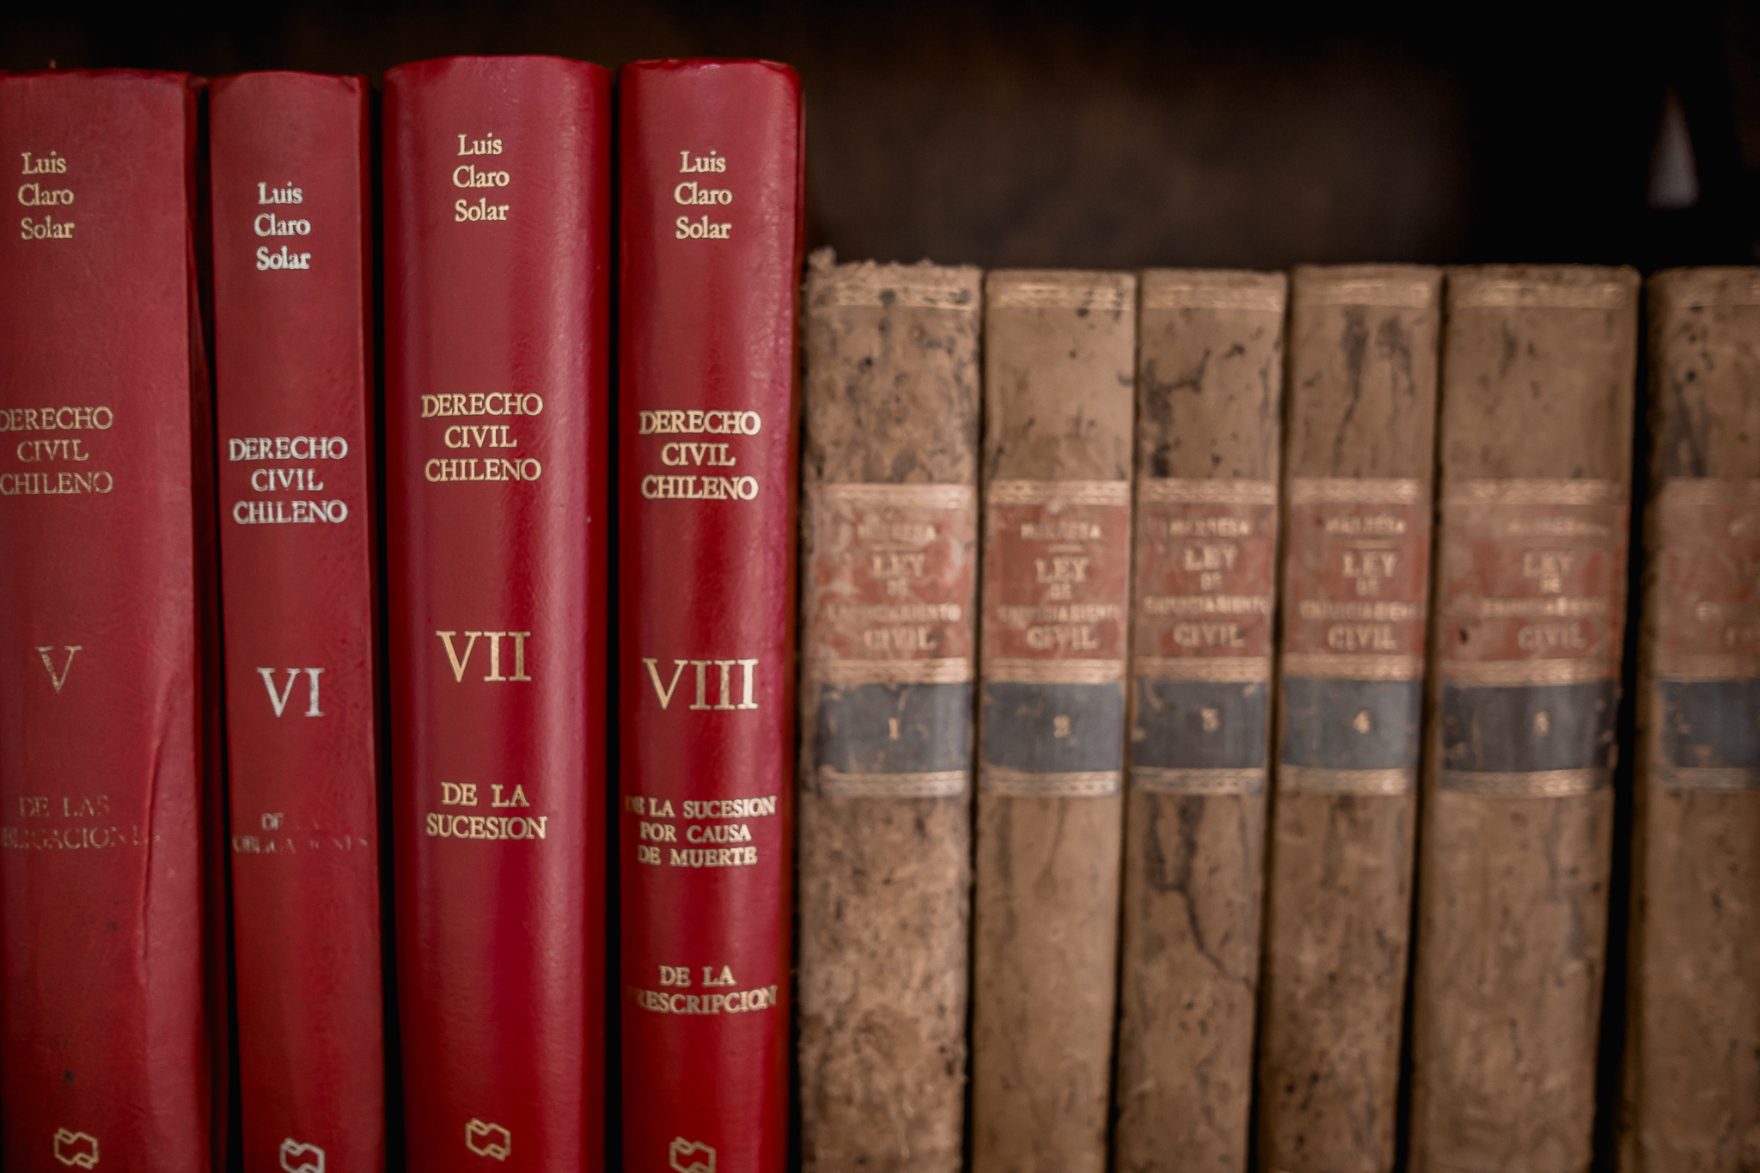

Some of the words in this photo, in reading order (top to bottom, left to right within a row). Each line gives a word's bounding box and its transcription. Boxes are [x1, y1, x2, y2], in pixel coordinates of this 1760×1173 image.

[458, 132, 503, 156] Luis
[21, 150, 67, 174] Luis
[680, 150, 726, 173] Luis
[453, 165, 510, 188] Claro
[18, 182, 74, 206] Claro
[258, 181, 303, 204] Luis
[674, 182, 732, 206] Claro
[455, 198, 509, 222] Solar
[21, 215, 75, 240] Solar
[254, 213, 311, 237] Claro
[676, 215, 732, 240] Solar
[256, 246, 311, 271] Solar
[421, 392, 543, 418] DERECHO
[640, 411, 761, 435] DERECHO
[229, 436, 348, 461] DERECHO
[444, 425, 517, 449] CIVIL
[17, 439, 89, 462] CIVIL
[661, 443, 736, 466] CIVIL
[251, 468, 324, 492] CIVIL
[425, 457, 541, 482] CHILENO
[0, 471, 113, 495] CHILENO
[641, 475, 759, 500] CHILENO
[233, 500, 348, 524] CHILENO
[1183, 544, 1237, 571] LEY
[1343, 553, 1397, 578] LEY
[1034, 557, 1089, 584] LEY
[1026, 624, 1097, 650] CIVIL
[1172, 622, 1245, 649] CIVIL
[1327, 624, 1397, 650] CIVIL
[436, 630, 531, 683] VII
[36, 646, 82, 693] V
[257, 667, 325, 717] VI
[642, 658, 759, 710] VIII
[441, 781, 478, 807] DE
[491, 783, 529, 807] LA
[648, 797, 676, 818] LA
[683, 796, 776, 820] SUCESION
[426, 814, 547, 840] SUCESION
[640, 821, 677, 842] POR
[687, 823, 752, 843] CAUSA
[638, 845, 662, 866] DE
[670, 846, 758, 868] MUERTE
[659, 965, 691, 987] DE
[702, 965, 737, 987] LA
[629, 984, 778, 1015] RESCRIPCION
